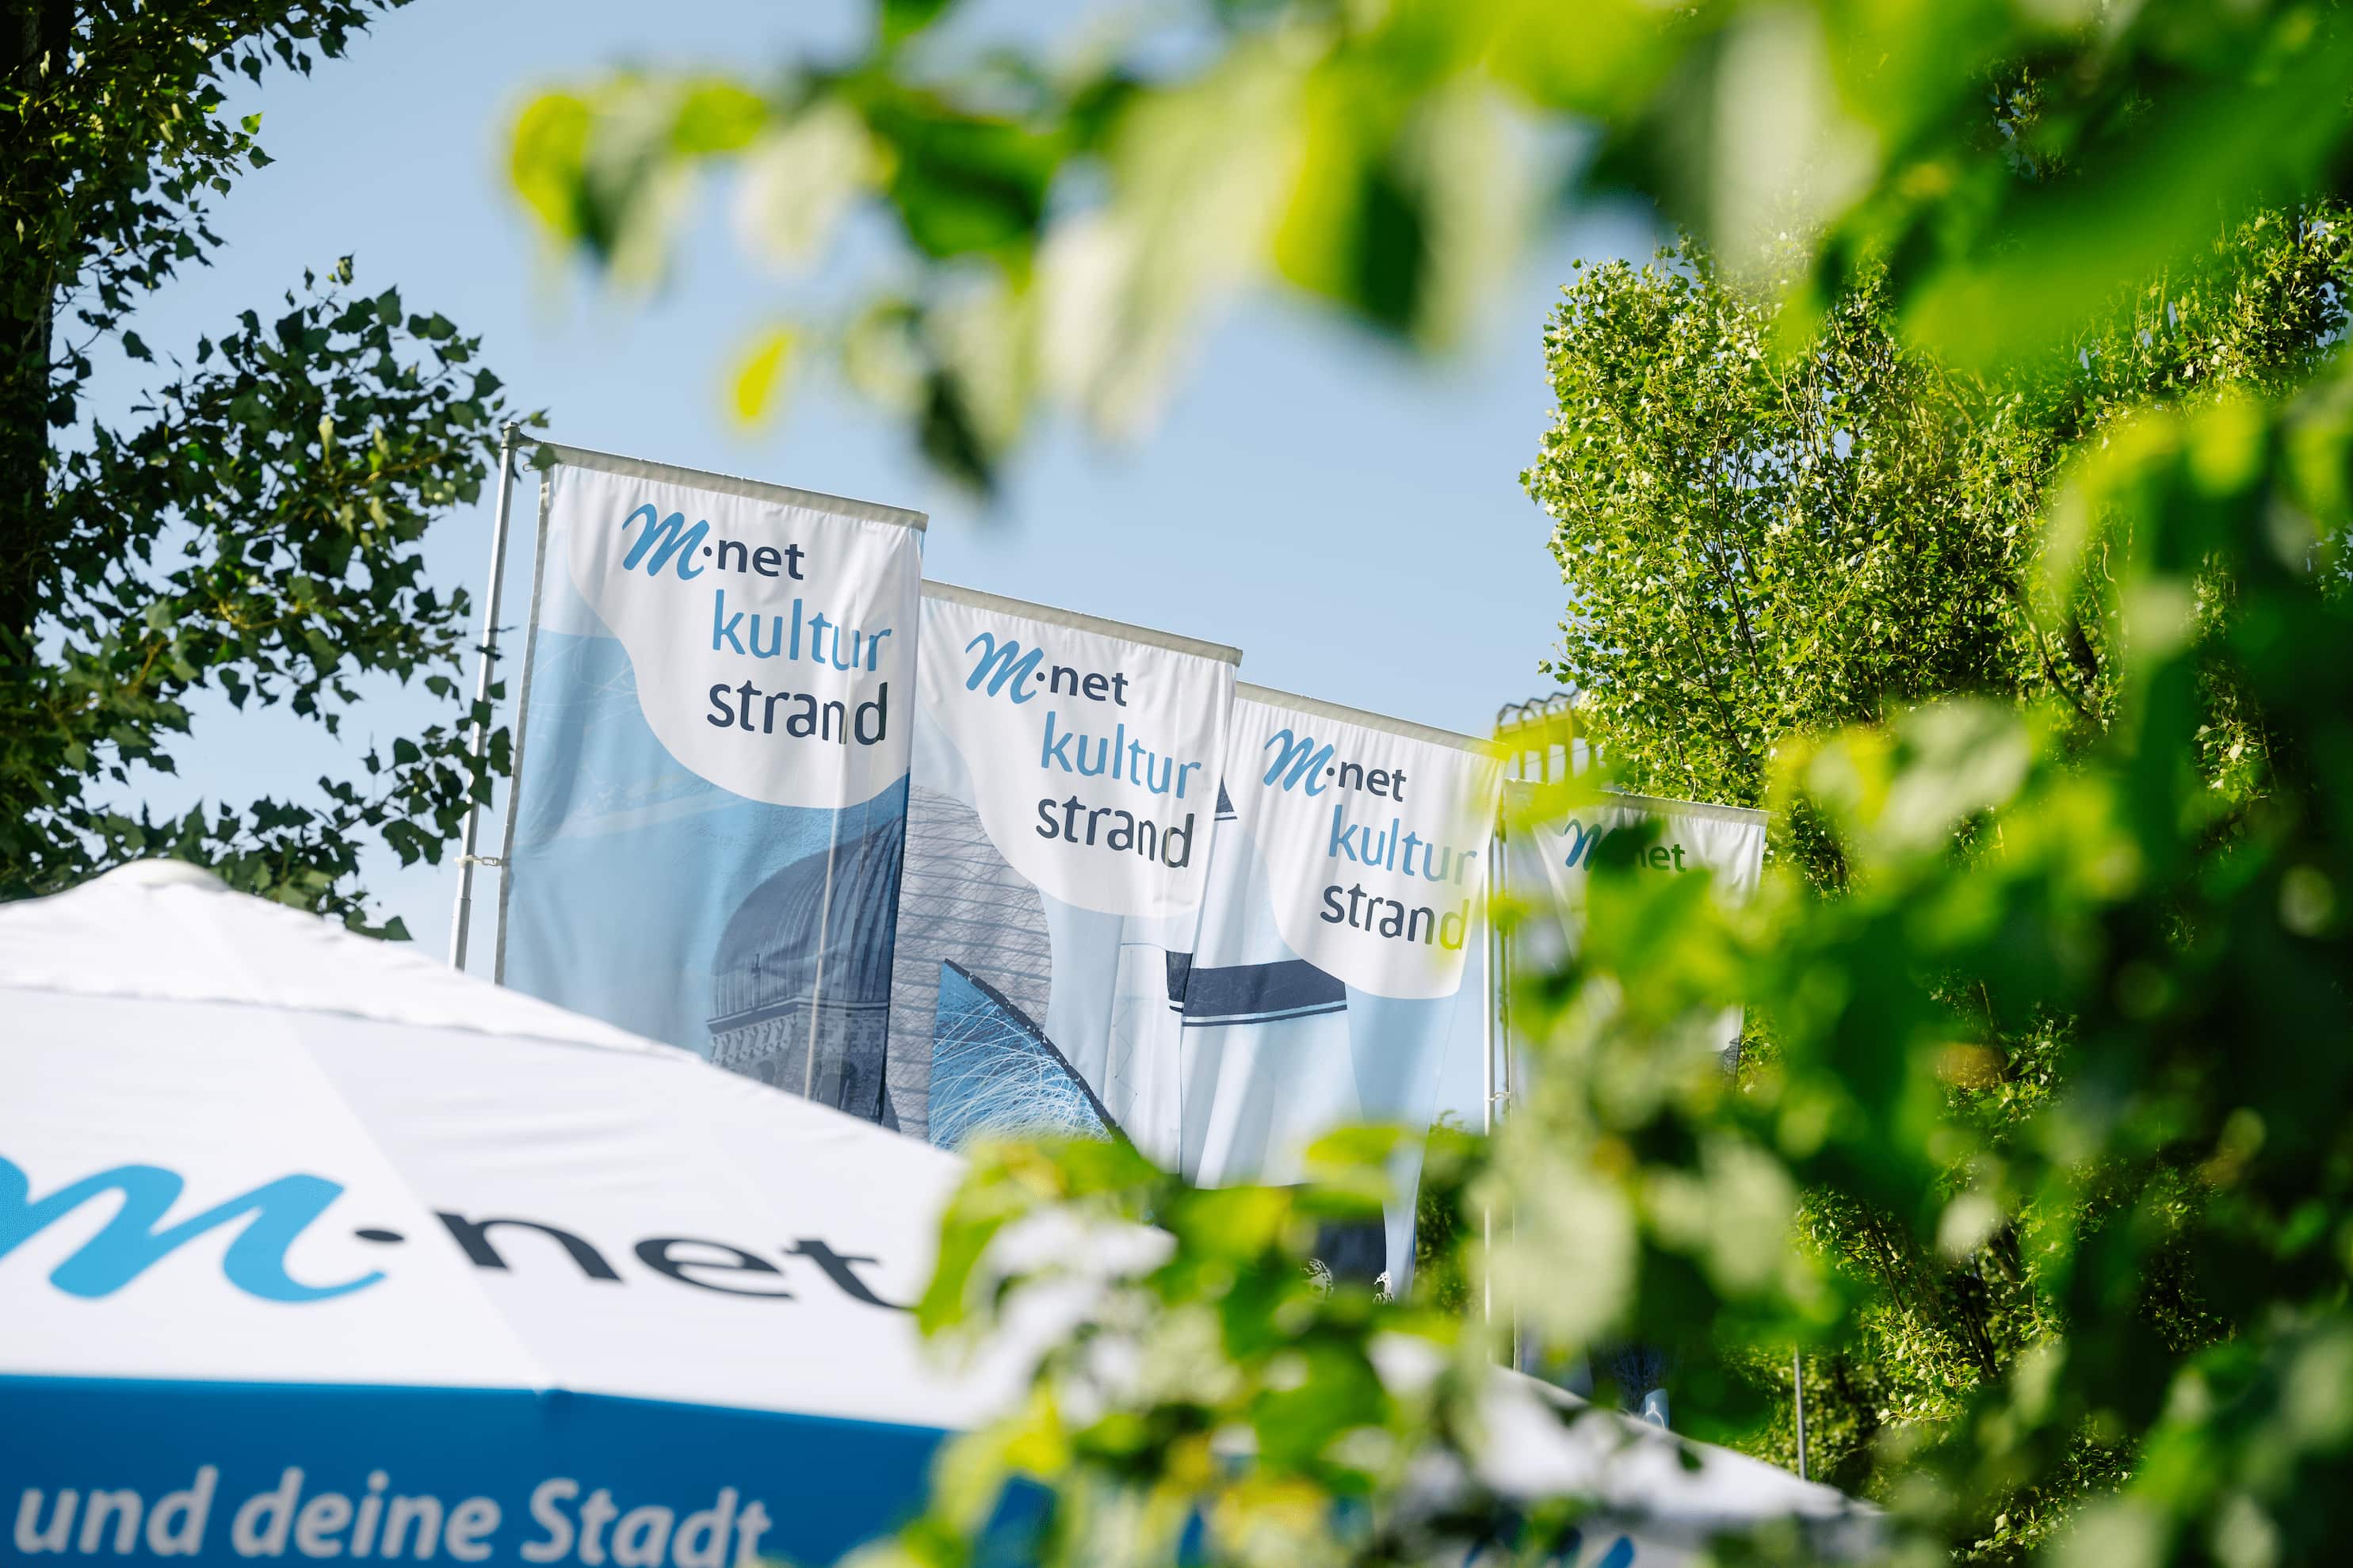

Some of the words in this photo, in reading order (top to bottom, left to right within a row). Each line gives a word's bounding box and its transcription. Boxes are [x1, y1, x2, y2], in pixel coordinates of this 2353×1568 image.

[712, 589, 892, 672] kultur
[707, 679, 888, 746] strand
[1041, 711, 1201, 799] kultur
[1036, 795, 1194, 868] strand
[1328, 803, 1477, 886] kultur
[1320, 883, 1470, 950] strand
[13, 1464, 220, 1556] und
[231, 1466, 502, 1562] deine
[520, 1477, 773, 1568] Stadt
